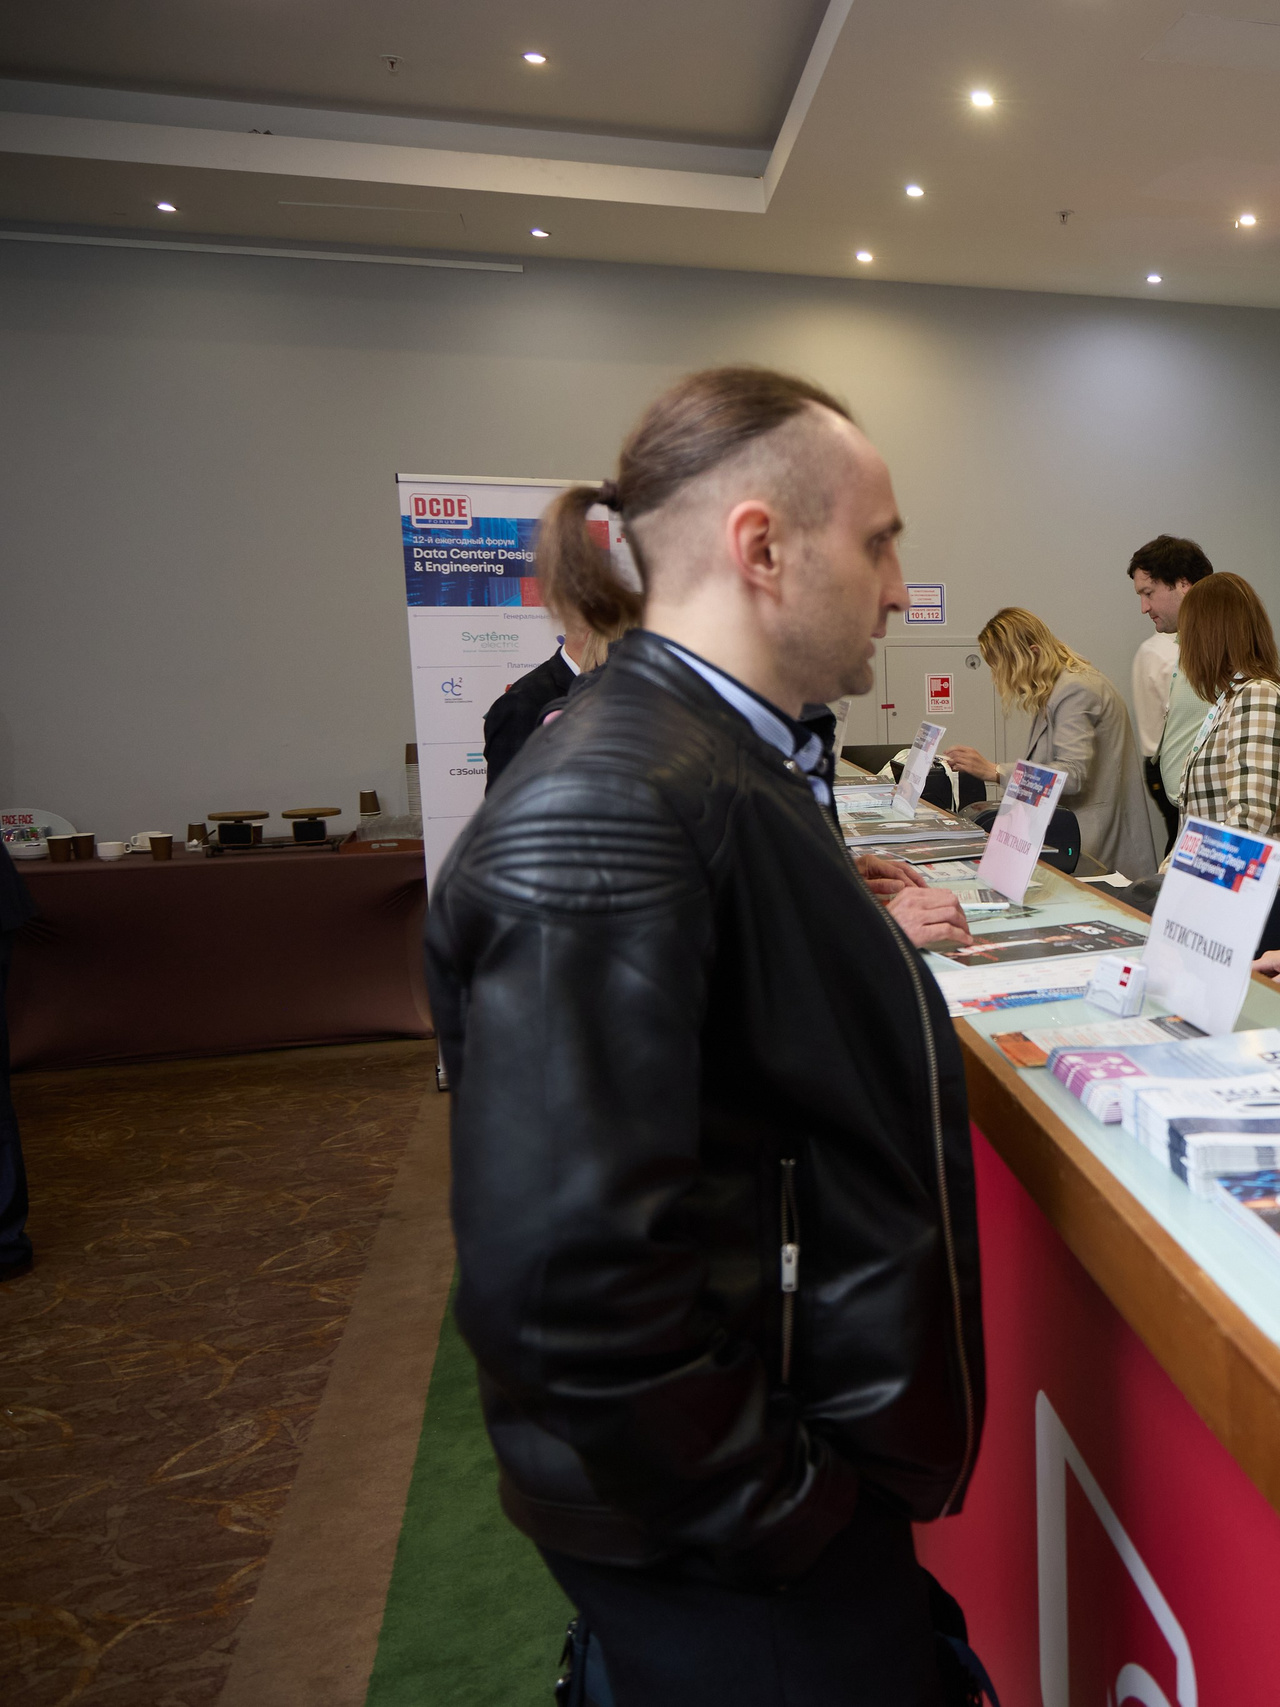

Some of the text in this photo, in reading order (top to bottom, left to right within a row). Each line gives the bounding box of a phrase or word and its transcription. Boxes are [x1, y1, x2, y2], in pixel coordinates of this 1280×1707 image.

[414, 497, 467, 517] DCDE
[435, 537, 484, 545] ежегодный
[486, 537, 515, 546] форум
[413, 548, 537, 562] Data Center Desig
[414, 562, 504, 575] & Engineering
[462, 631, 519, 643] Système
[450, 768, 487, 776] C3Soluti
[1163, 918, 1234, 968] РЕГИСТРАЦИЯ
